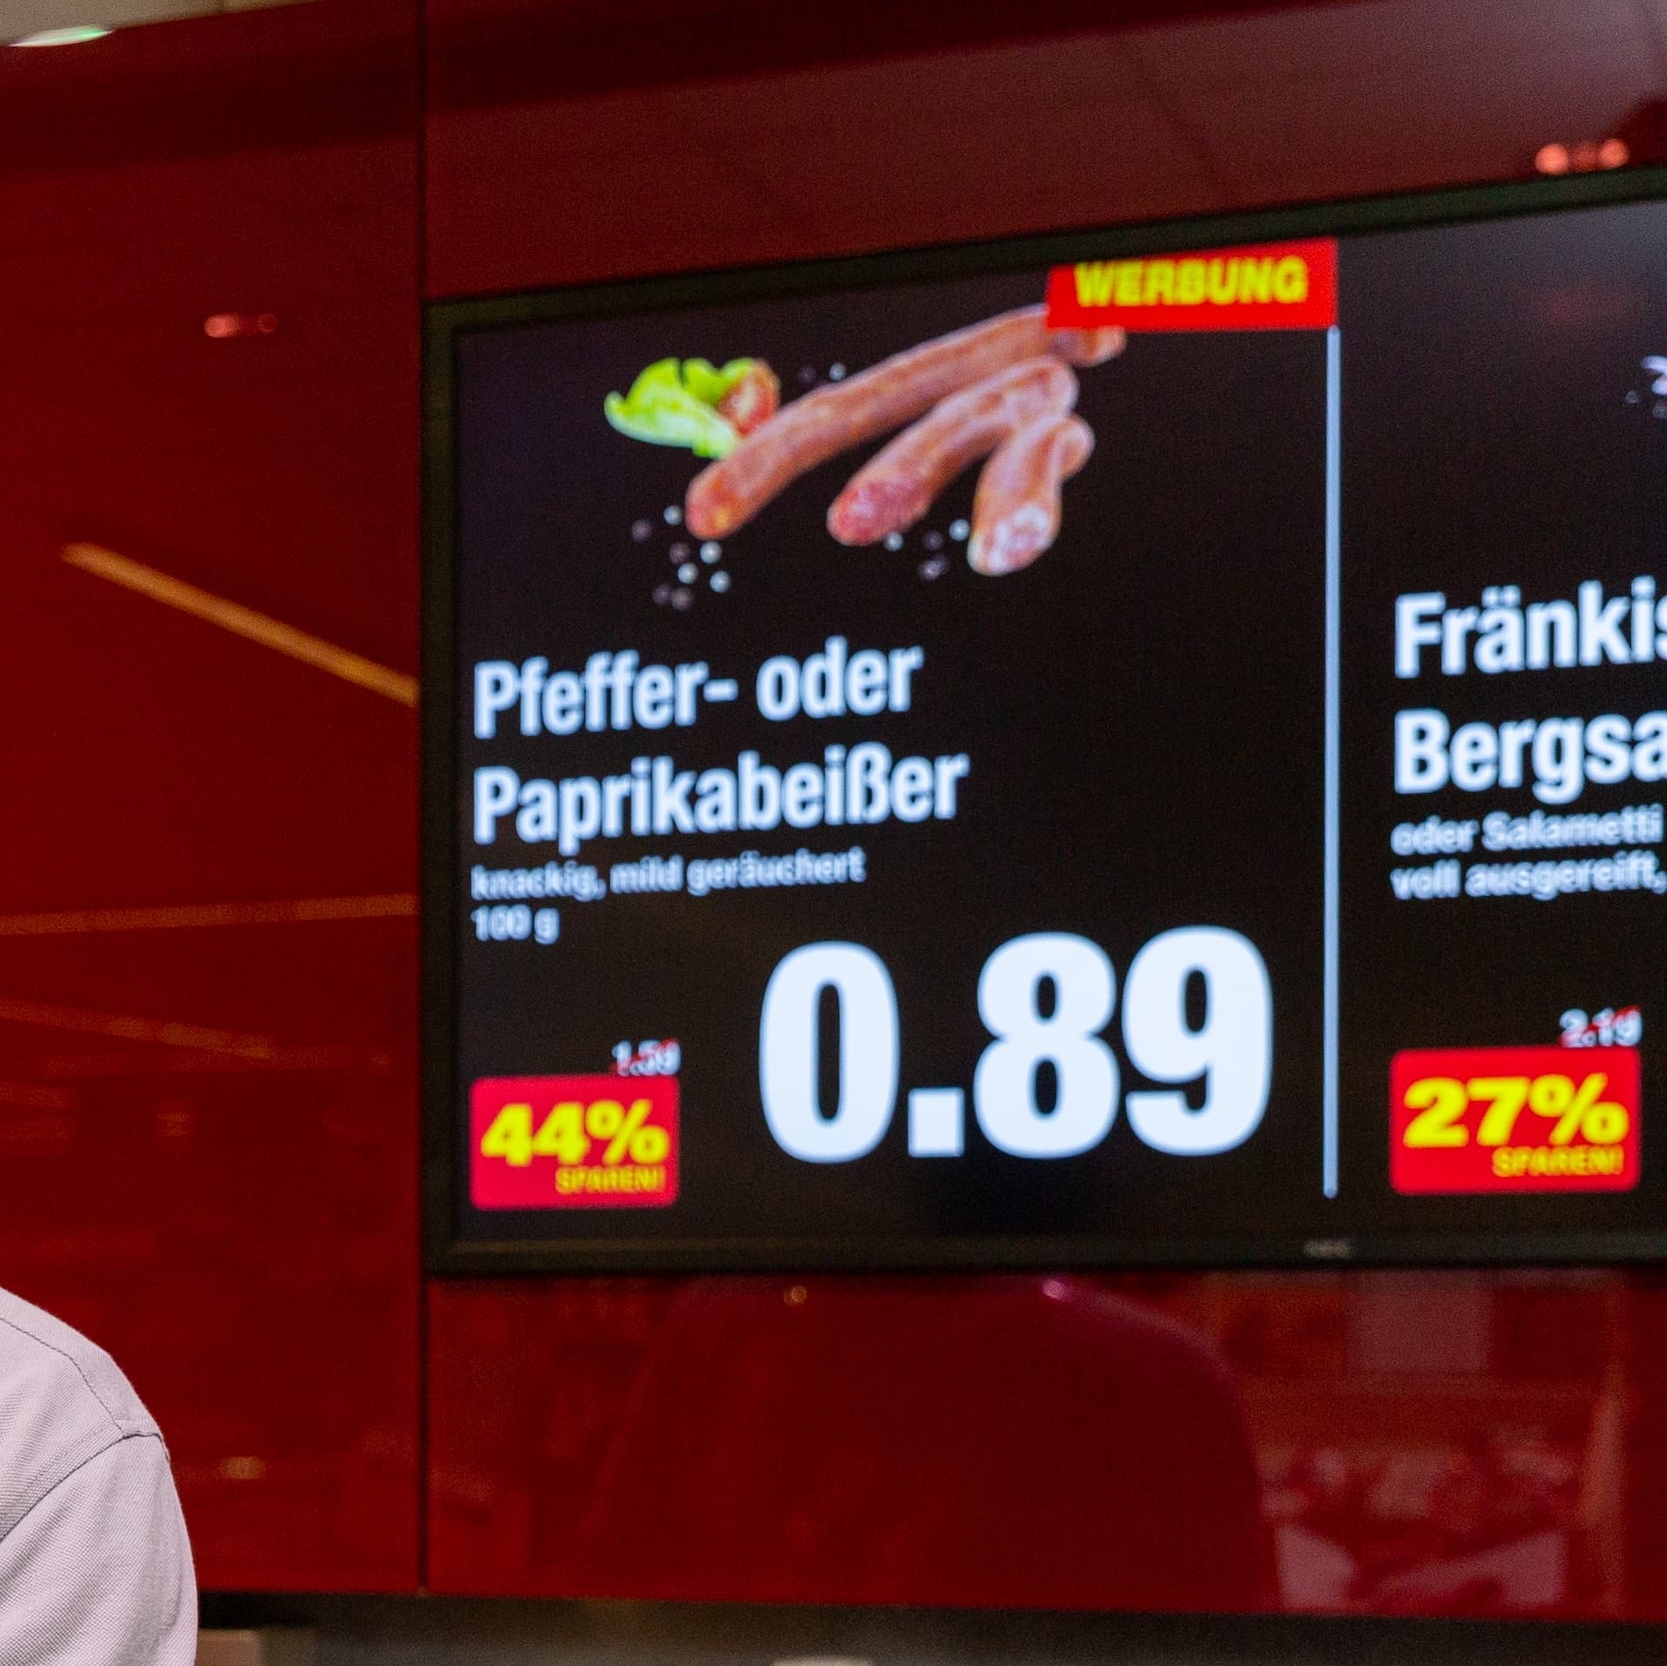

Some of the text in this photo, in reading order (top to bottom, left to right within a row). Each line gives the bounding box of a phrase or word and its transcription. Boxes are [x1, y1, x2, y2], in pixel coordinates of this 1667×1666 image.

[1074, 255, 1309, 307] WERBUNG
[473, 635, 924, 739] Pfeffer- oder
[473, 741, 970, 856] Paprikabeißer
[1390, 814, 1479, 856] oder
[470, 846, 867, 902] knackig, mild geräuchert
[1390, 859, 1461, 900] voll
[470, 904, 560, 945] 100 g
[757, 924, 1274, 1164] 0.89
[480, 1098, 669, 1167] 44%
[1403, 1072, 1630, 1148] 27%
